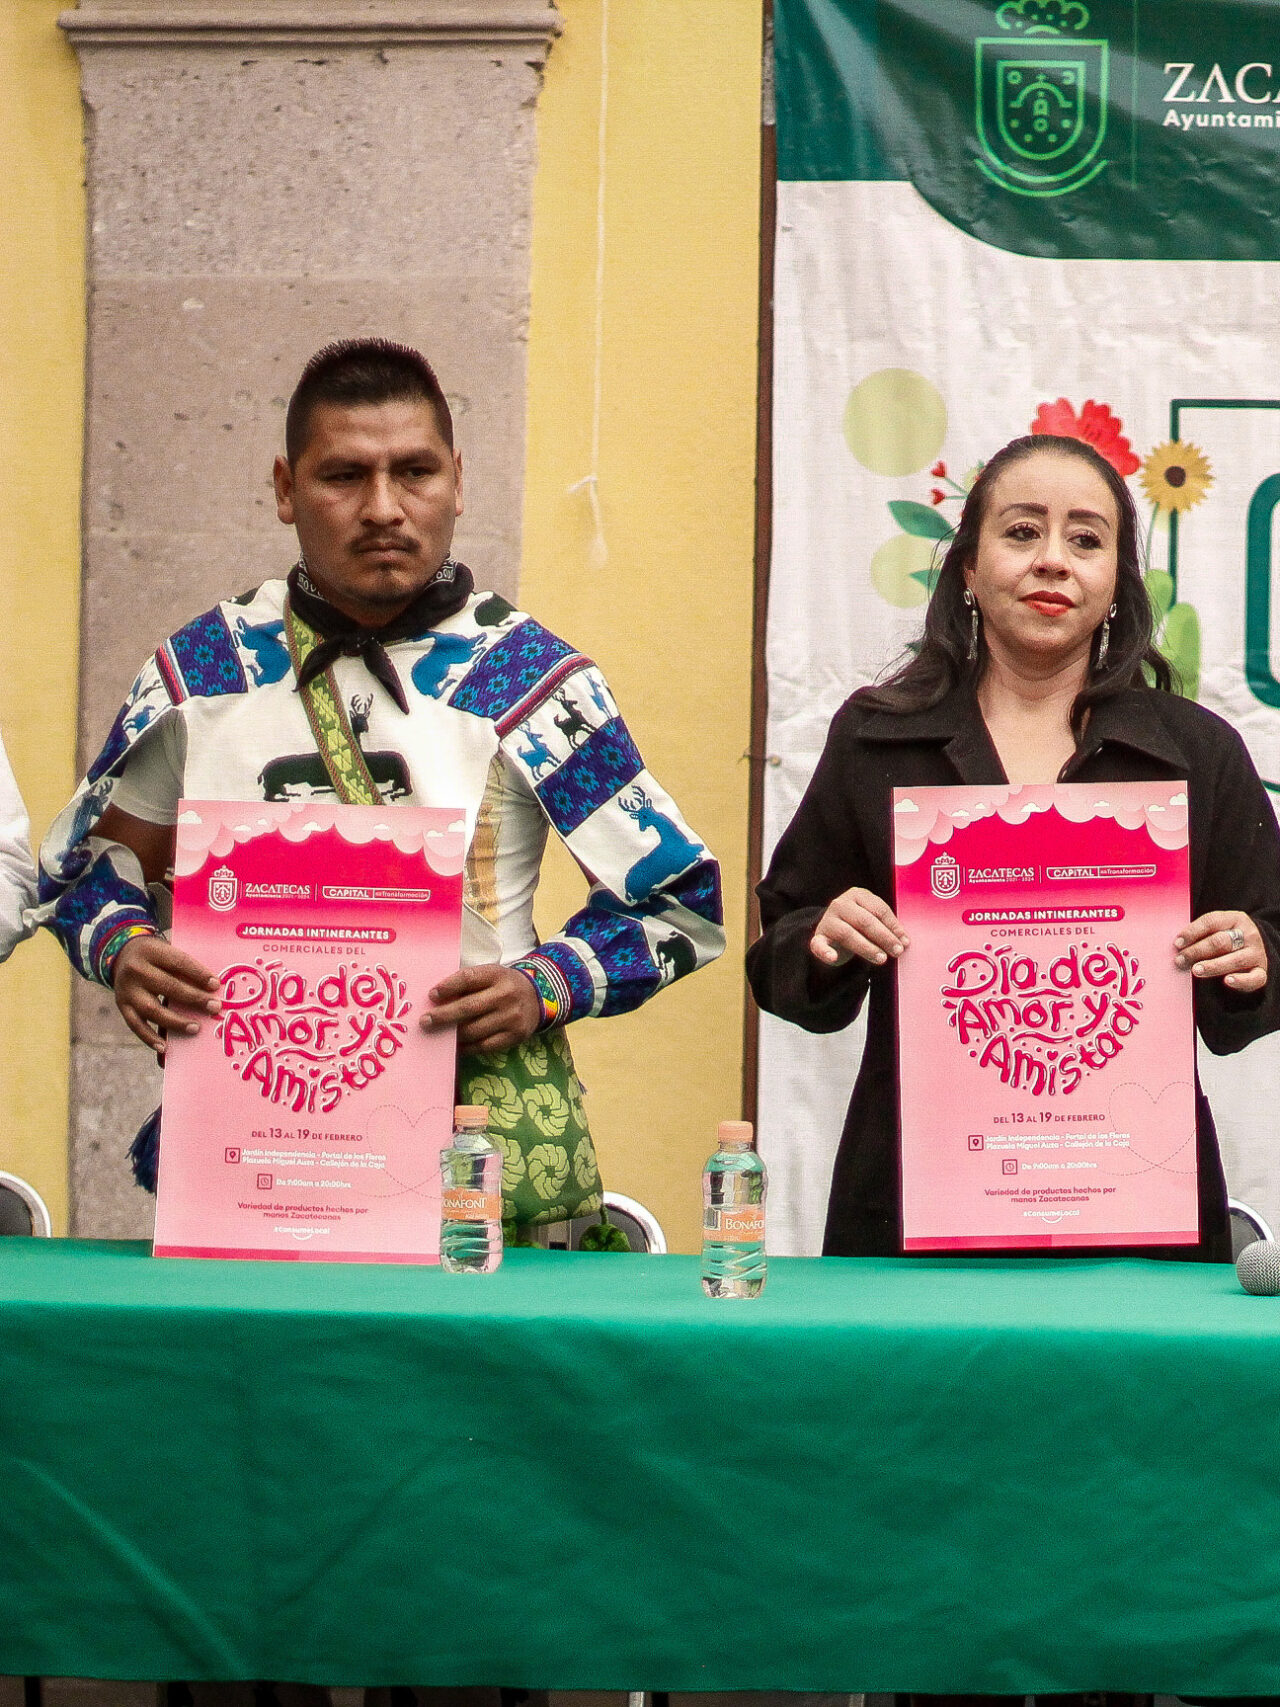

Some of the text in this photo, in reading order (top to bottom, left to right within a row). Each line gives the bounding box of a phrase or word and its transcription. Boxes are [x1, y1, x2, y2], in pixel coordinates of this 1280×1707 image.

[967, 866, 1034, 878] ZACATECAS
[1052, 868, 1094, 877] CAPITAL
[244, 882, 310, 894] ZACATECAS
[328, 888, 369, 898] CAPITAL
[968, 908, 1118, 921] JORNADAS INTINERANTES
[242, 926, 389, 940] JORNADAS INTINERANTES
[990, 926, 1095, 937] COMERCIALES DEL
[262, 943, 366, 955] COMERCIALES DEL
[941, 941, 1128, 999] Día del
[219, 958, 397, 1019] Día del
[953, 994, 1074, 1045] Amor
[219, 1009, 339, 1061] Amor
[977, 998, 1141, 1096] Amistad
[239, 1016, 404, 1116] Amistad
[1010, 1112, 1024, 1123] 13
[1038, 1111, 1052, 1122] 19
[268, 1127, 282, 1138] 13
[283, 1131, 295, 1139] AL
[296, 1128, 310, 1139] 19
[311, 1132, 322, 1140] DE
[324, 1133, 362, 1141] FEBRERO
[984, 1187, 1020, 1195] Variedad
[1020, 1187, 1031, 1195] de
[1032, 1186, 1072, 1196] productos
[1073, 1186, 1101, 1194] hechos
[1038, 1194, 1089, 1203] Zacatecanas
[236, 1201, 272, 1210] Variedad
[724, 1217, 764, 1231] BONAFO
